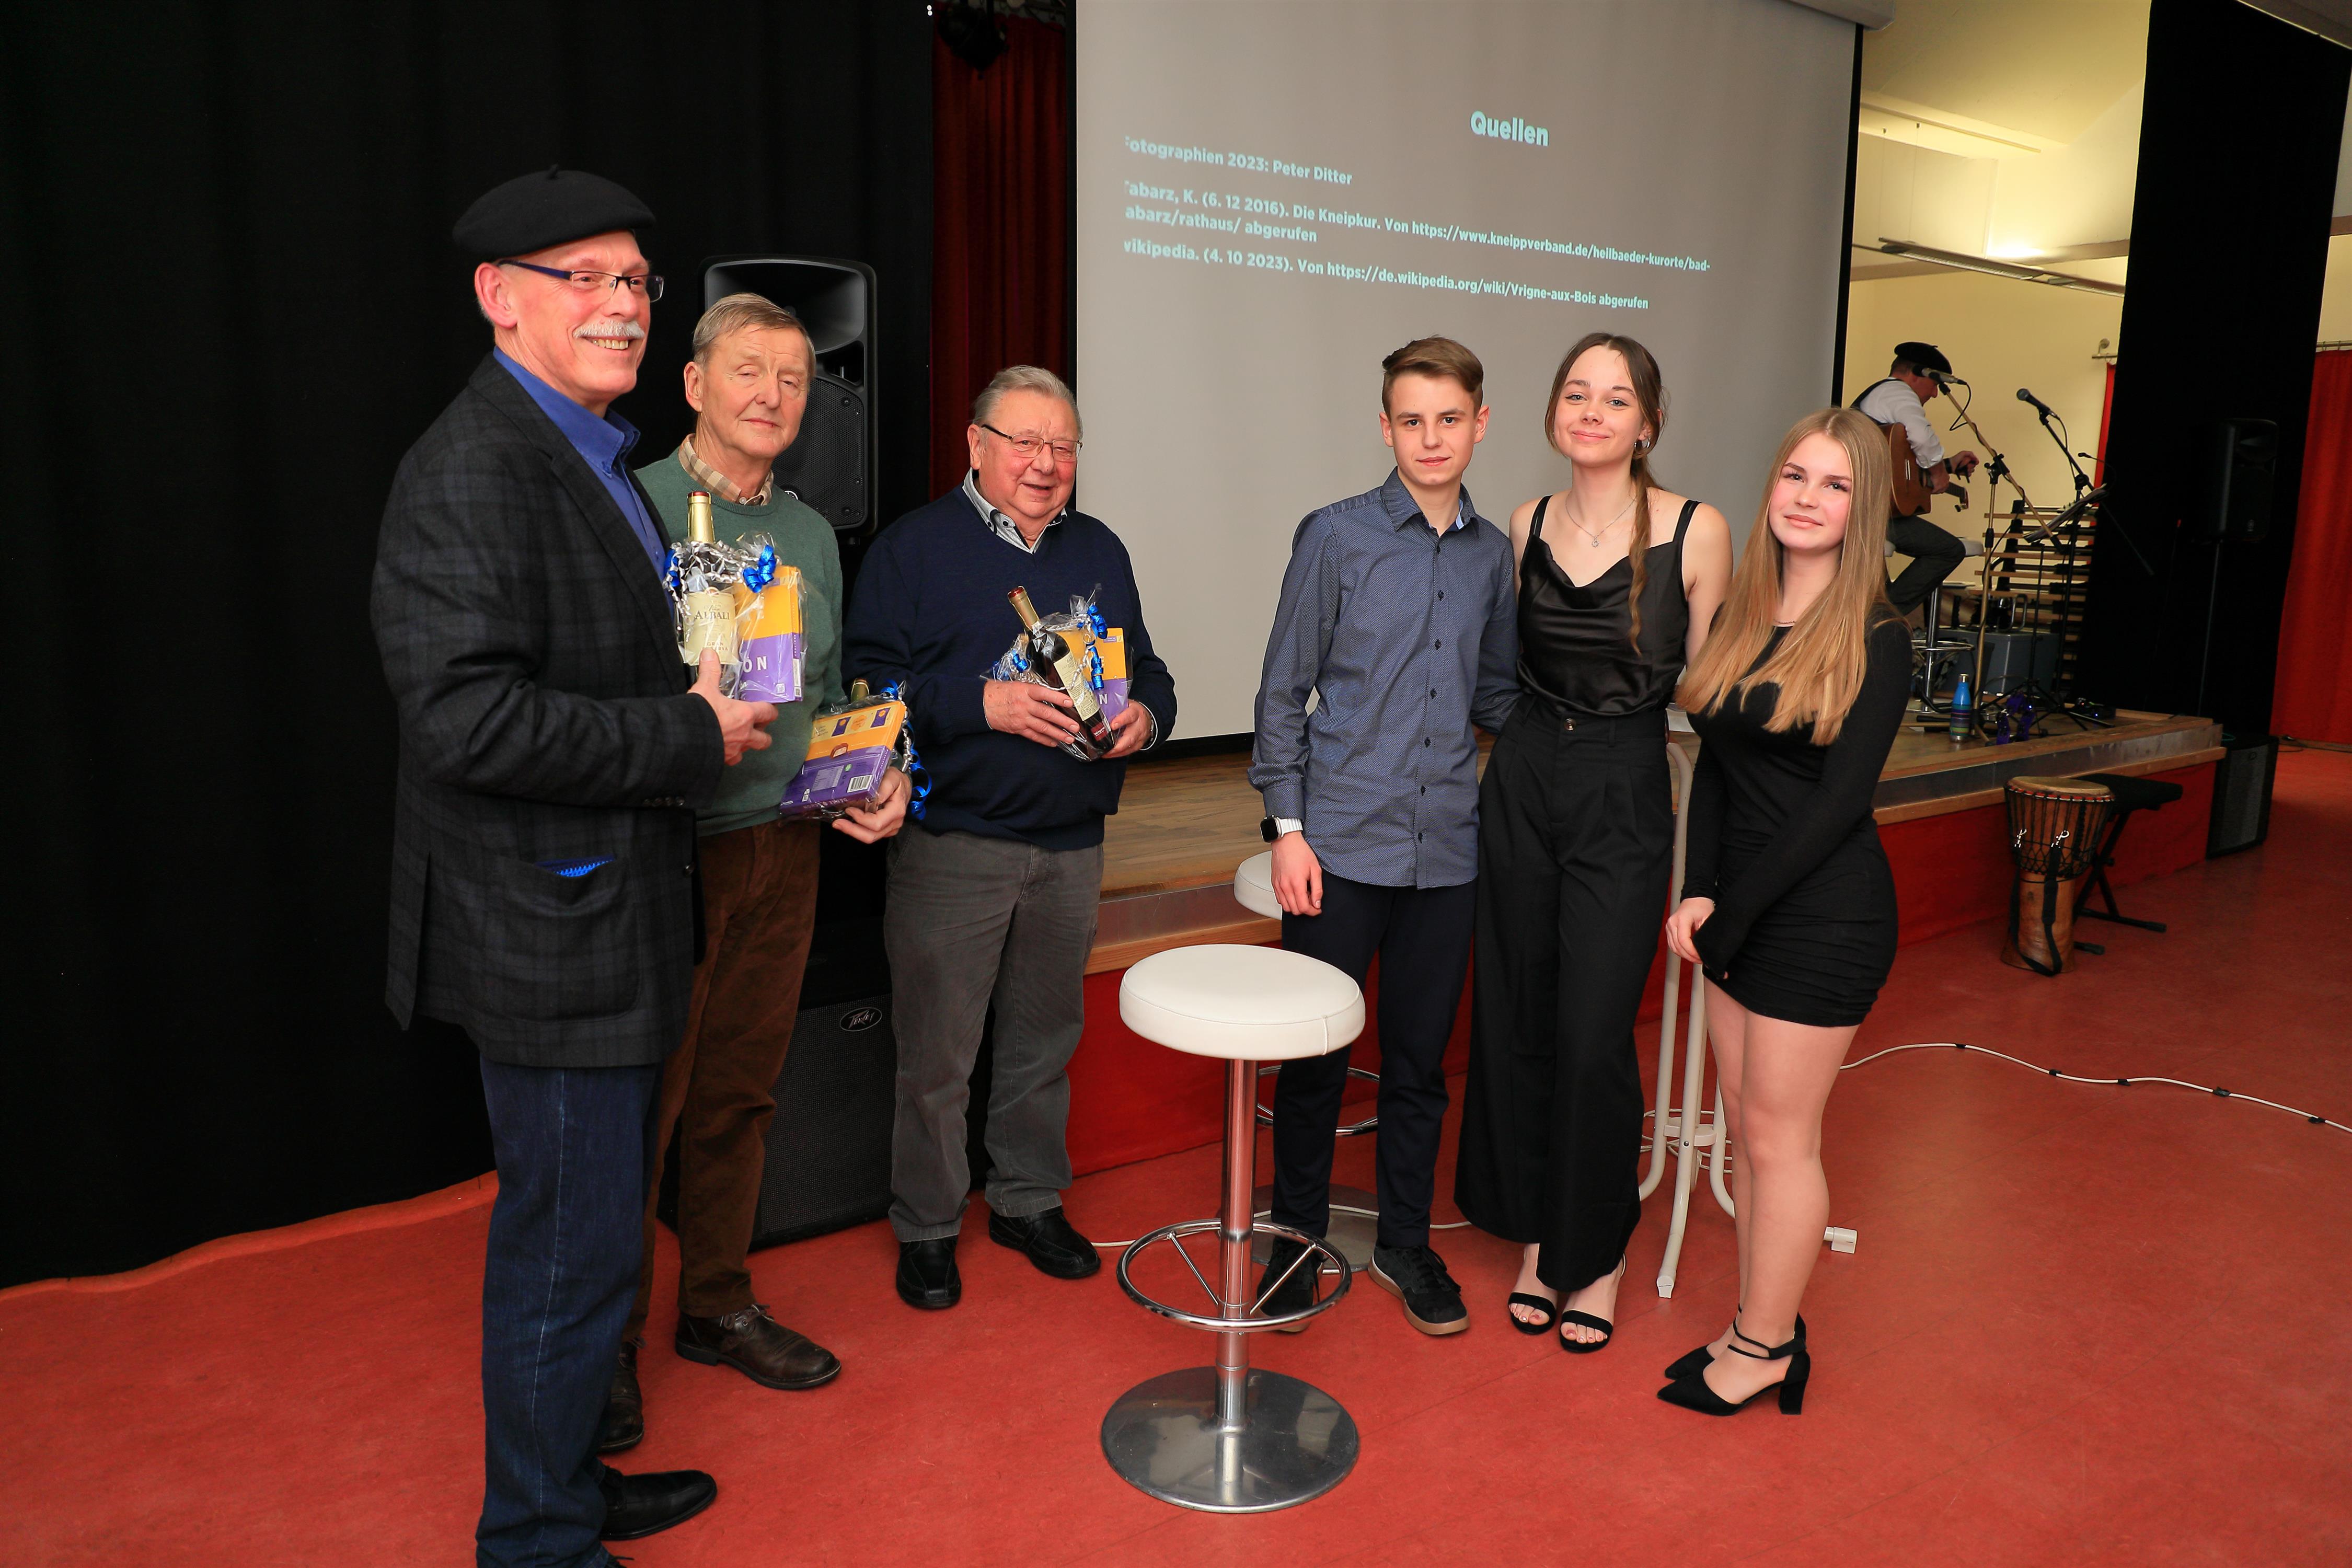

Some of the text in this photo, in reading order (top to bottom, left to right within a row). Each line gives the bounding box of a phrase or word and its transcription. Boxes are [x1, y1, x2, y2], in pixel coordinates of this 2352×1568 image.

[1470, 111, 1549, 146] Quellen
[1227, 153, 1269, 171] 2023:
[1272, 159, 1310, 178] Peter
[1313, 167, 1352, 184] Ditter
[1183, 190, 1198, 204] K.
[1202, 192, 1221, 206] (6.
[1226, 195, 1240, 209] 12
[1244, 198, 1288, 217] 2016).
[1293, 205, 1315, 220] Die
[1318, 209, 1380, 229] Kneipkur.
[1385, 217, 1409, 234] Von
[1246, 222, 1317, 242] abgerufen
[1203, 249, 1223, 263] (4.
[1228, 251, 1243, 264] 10
[1247, 253, 1293, 272] 2023).
[1298, 259, 1324, 274] Von
[1599, 293, 1649, 309] abgerufen
[694, 610, 730, 619] ALBALI
